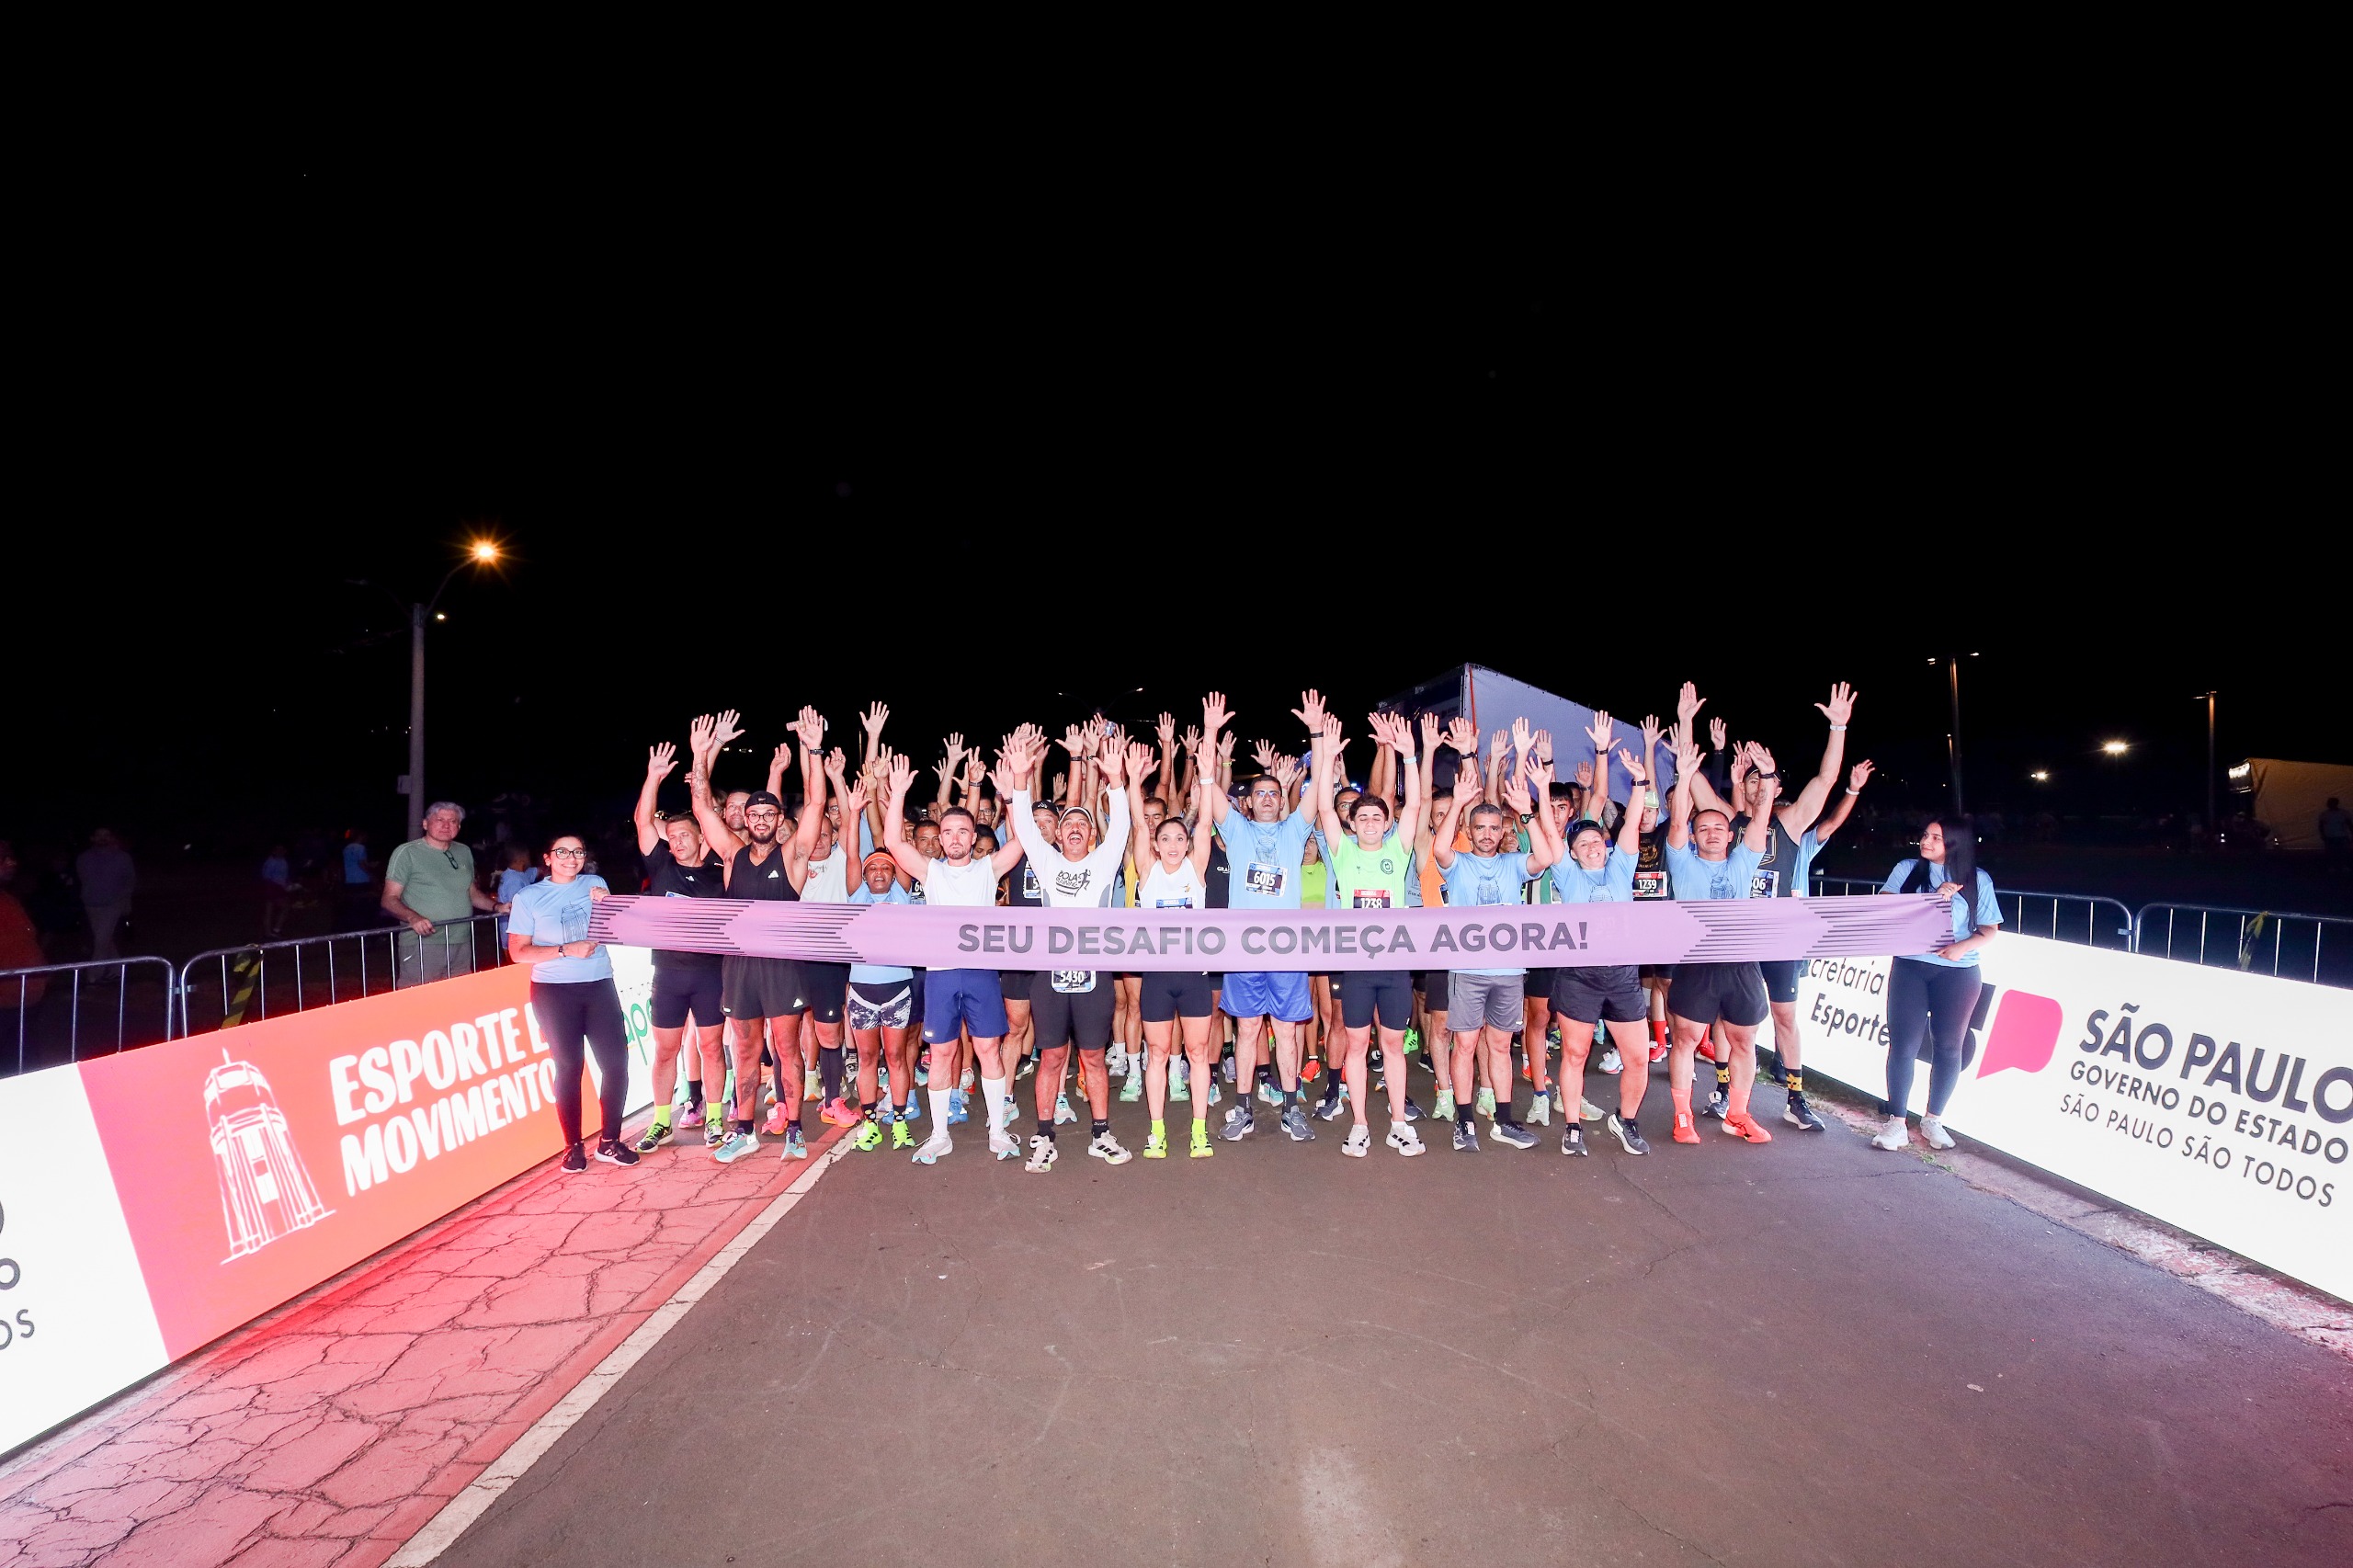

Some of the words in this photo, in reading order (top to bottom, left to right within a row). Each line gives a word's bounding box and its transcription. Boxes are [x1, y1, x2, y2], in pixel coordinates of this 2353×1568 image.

[1254, 871, 1276, 887] 6015
[1639, 879, 1657, 890] 1239
[1360, 897, 1382, 908] 1238
[958, 924, 1033, 953] SEU
[1048, 926, 1226, 955] DESAFIO
[1241, 925, 1416, 960] COMEÇA
[1429, 922, 1587, 952] AGORA!
[1060, 971, 1085, 983] 5430
[1809, 958, 1885, 995] cretaria
[329, 1007, 526, 1126] ESPORTE
[2079, 1003, 2173, 1070] SÃO
[2179, 1032, 2353, 1124] PAULO
[340, 1058, 557, 1197] MOVIMENTO
[2070, 1061, 2180, 1110] GOVERNO
[2188, 1096, 2227, 1126] DO
[2234, 1108, 2349, 1165] ESTADO
[2060, 1093, 2099, 1122] SÃO
[2106, 1109, 2174, 1149] PAULO
[2182, 1135, 2232, 1170] SÃO
[2243, 1155, 2336, 1208] TODOS
